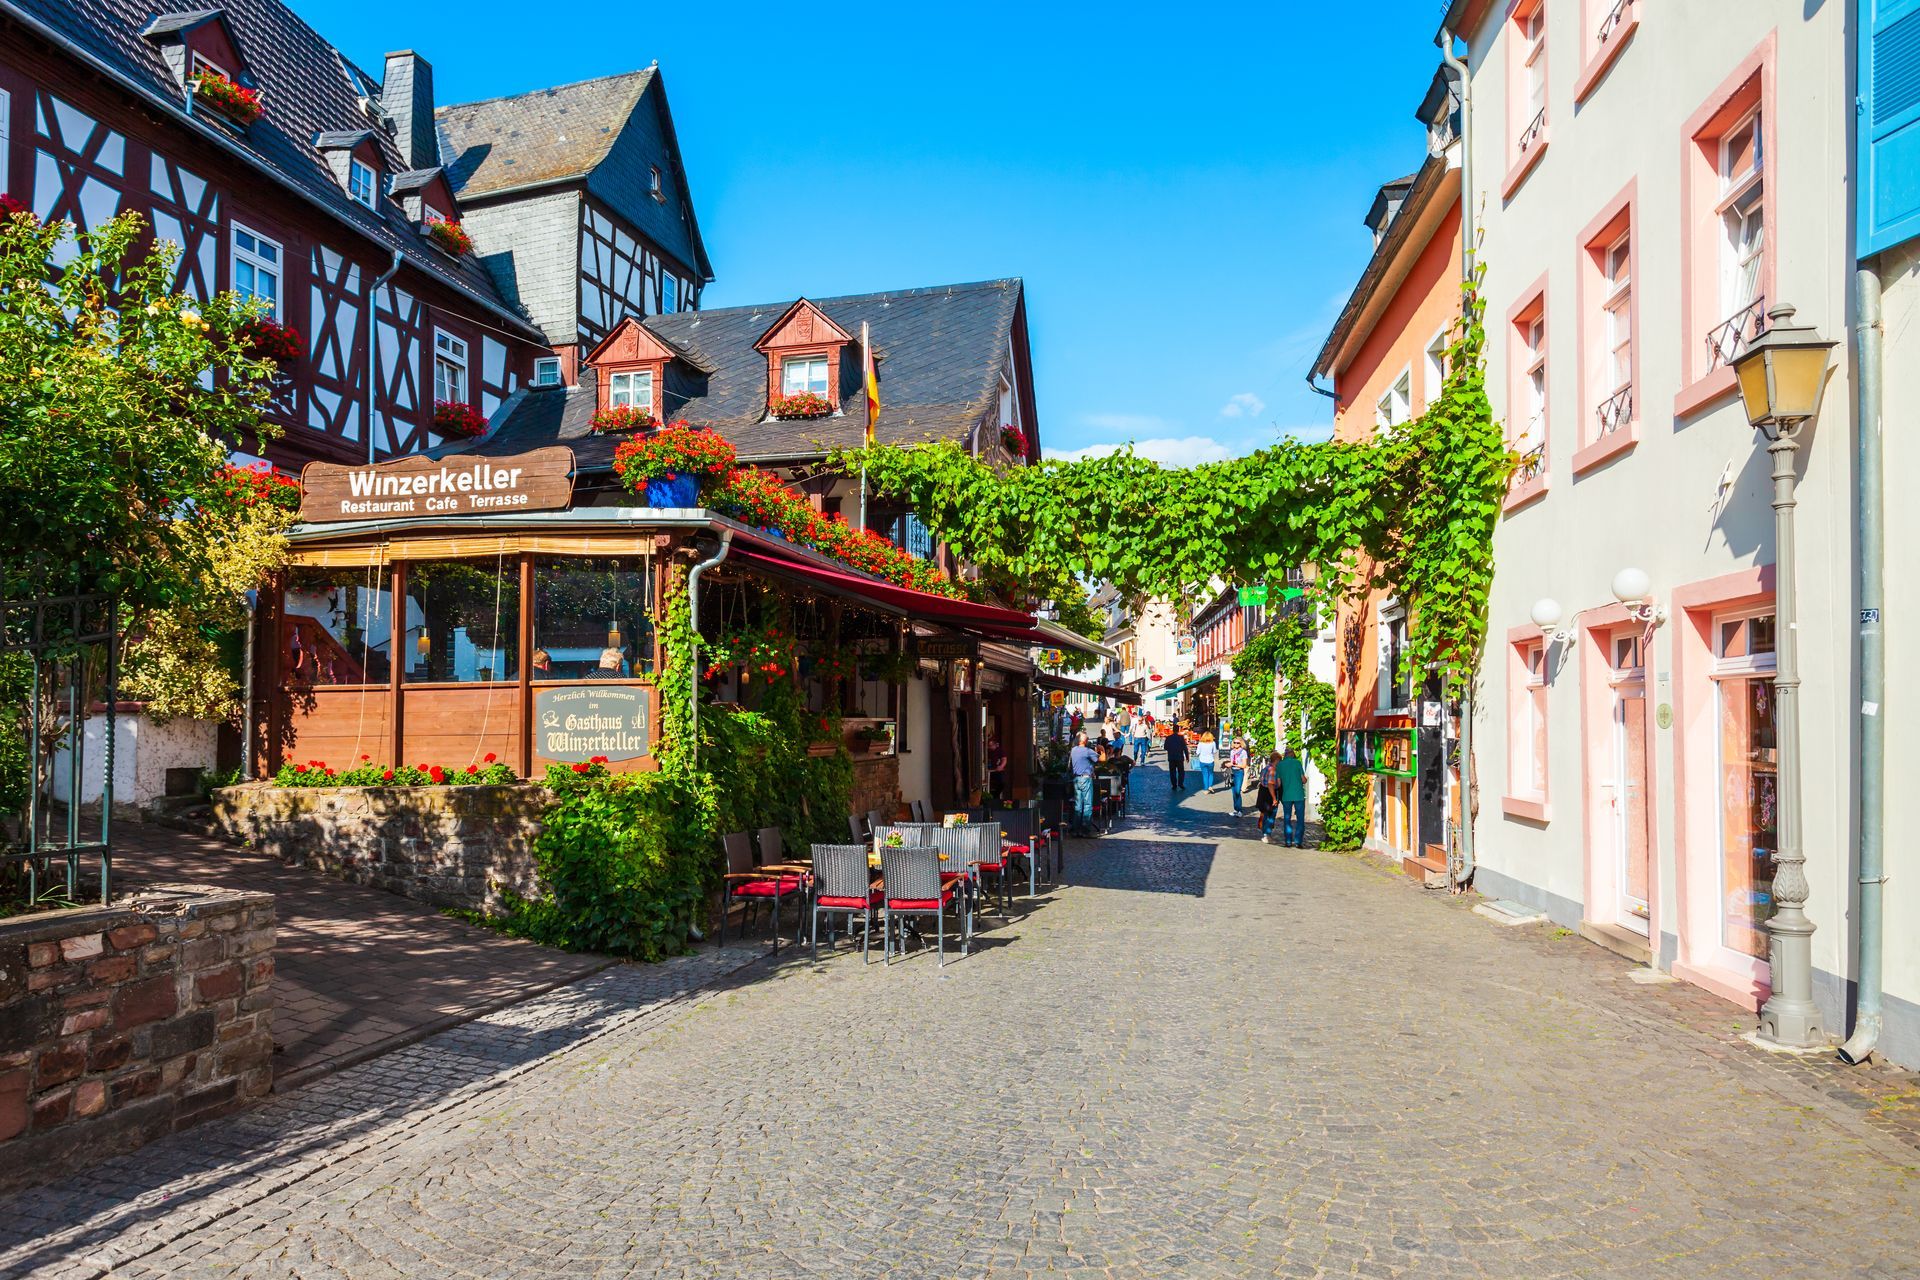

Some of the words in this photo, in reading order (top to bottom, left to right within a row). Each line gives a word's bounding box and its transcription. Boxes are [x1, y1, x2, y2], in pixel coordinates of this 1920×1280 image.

[349, 464, 522, 496] Winzerkeller
[341, 499, 415, 513] Restaurant
[425, 496, 458, 511] Cafe
[468, 493, 528, 508] Terrasse
[552, 689, 586, 702] Herzlich
[587, 690, 635, 701] Willkommen
[588, 701, 599, 709] im
[565, 714, 622, 732] Gasthaus
[546, 732, 641, 755] Winzerkeller
